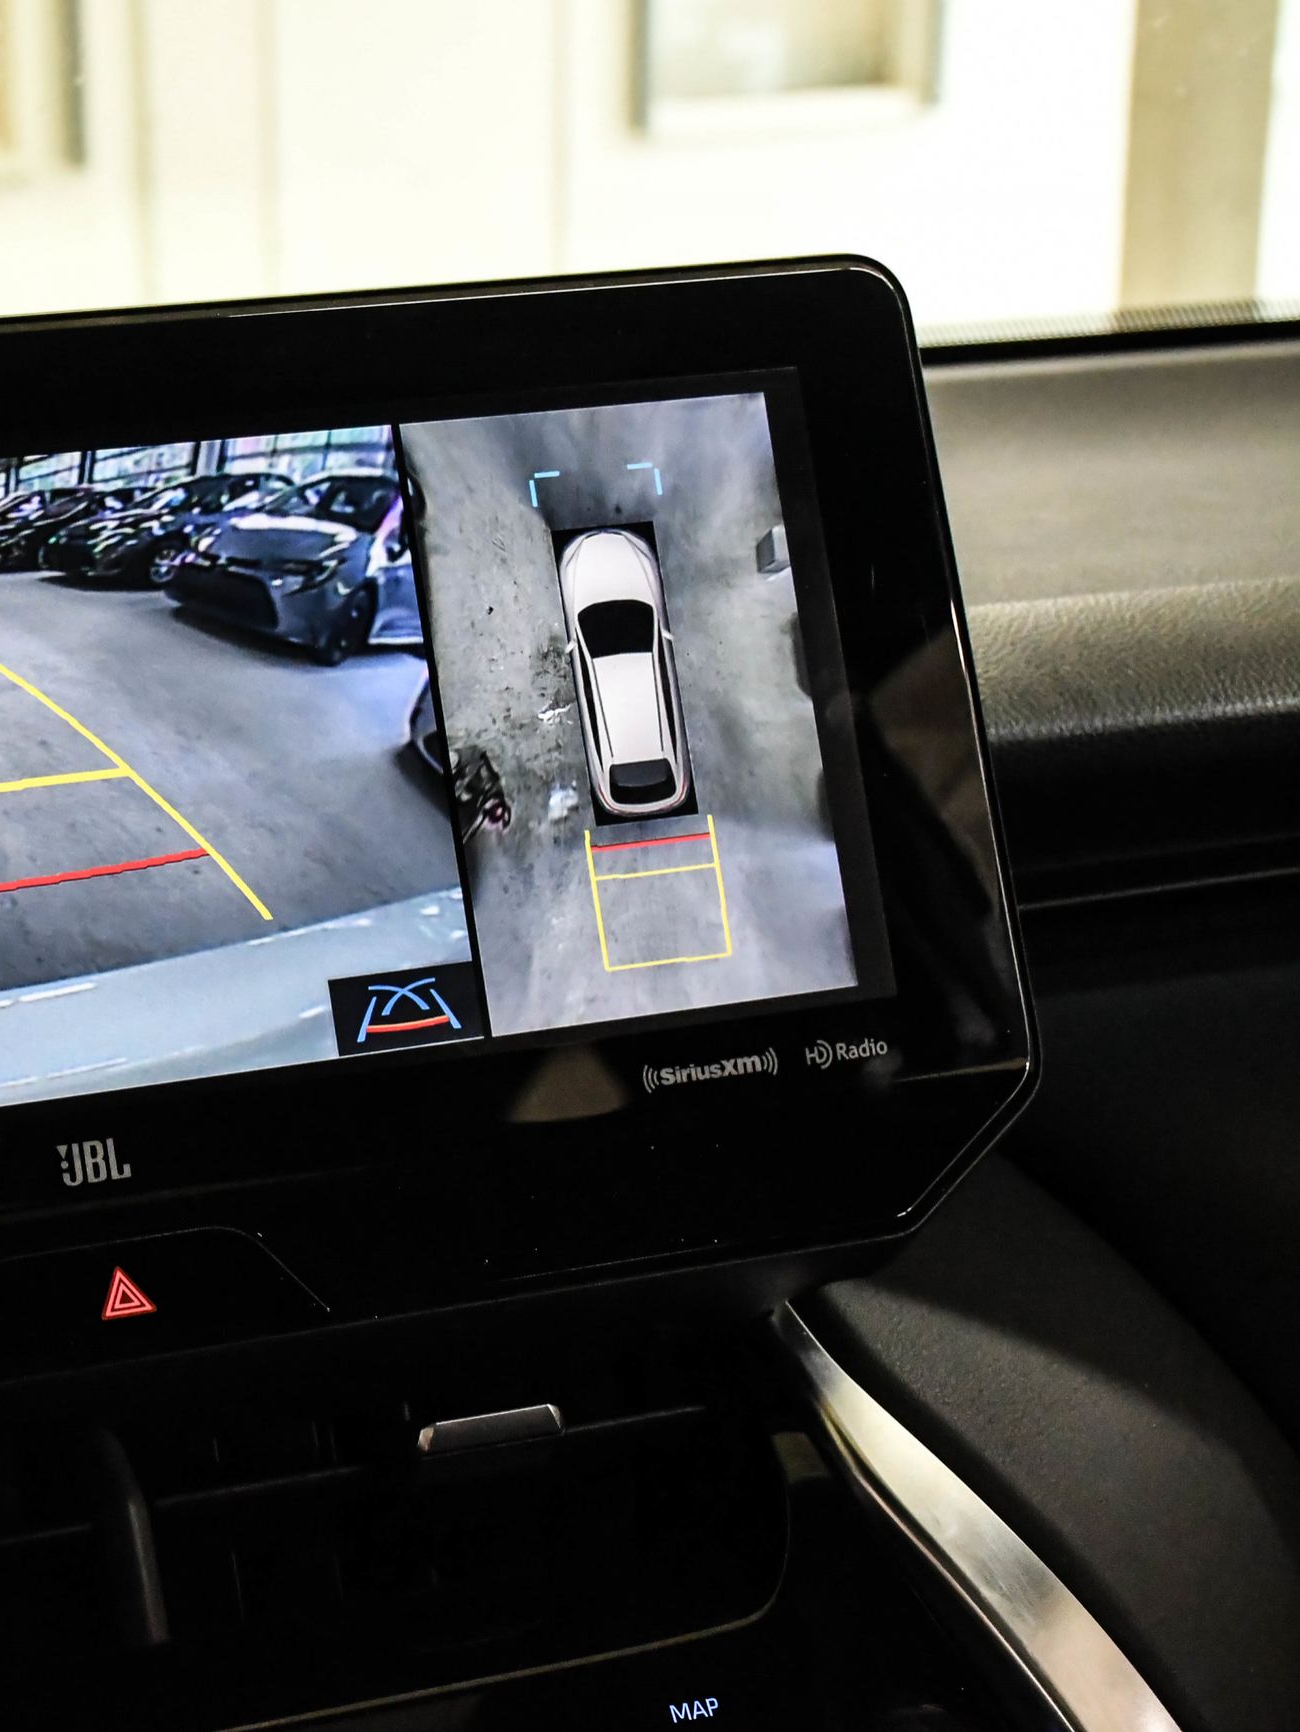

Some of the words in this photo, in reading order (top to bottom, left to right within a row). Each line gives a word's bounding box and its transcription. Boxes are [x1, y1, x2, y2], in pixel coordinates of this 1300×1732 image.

[835, 1038, 888, 1061] Radio
[62, 1138, 132, 1187] JBL
[669, 1697, 719, 1723] MAP
